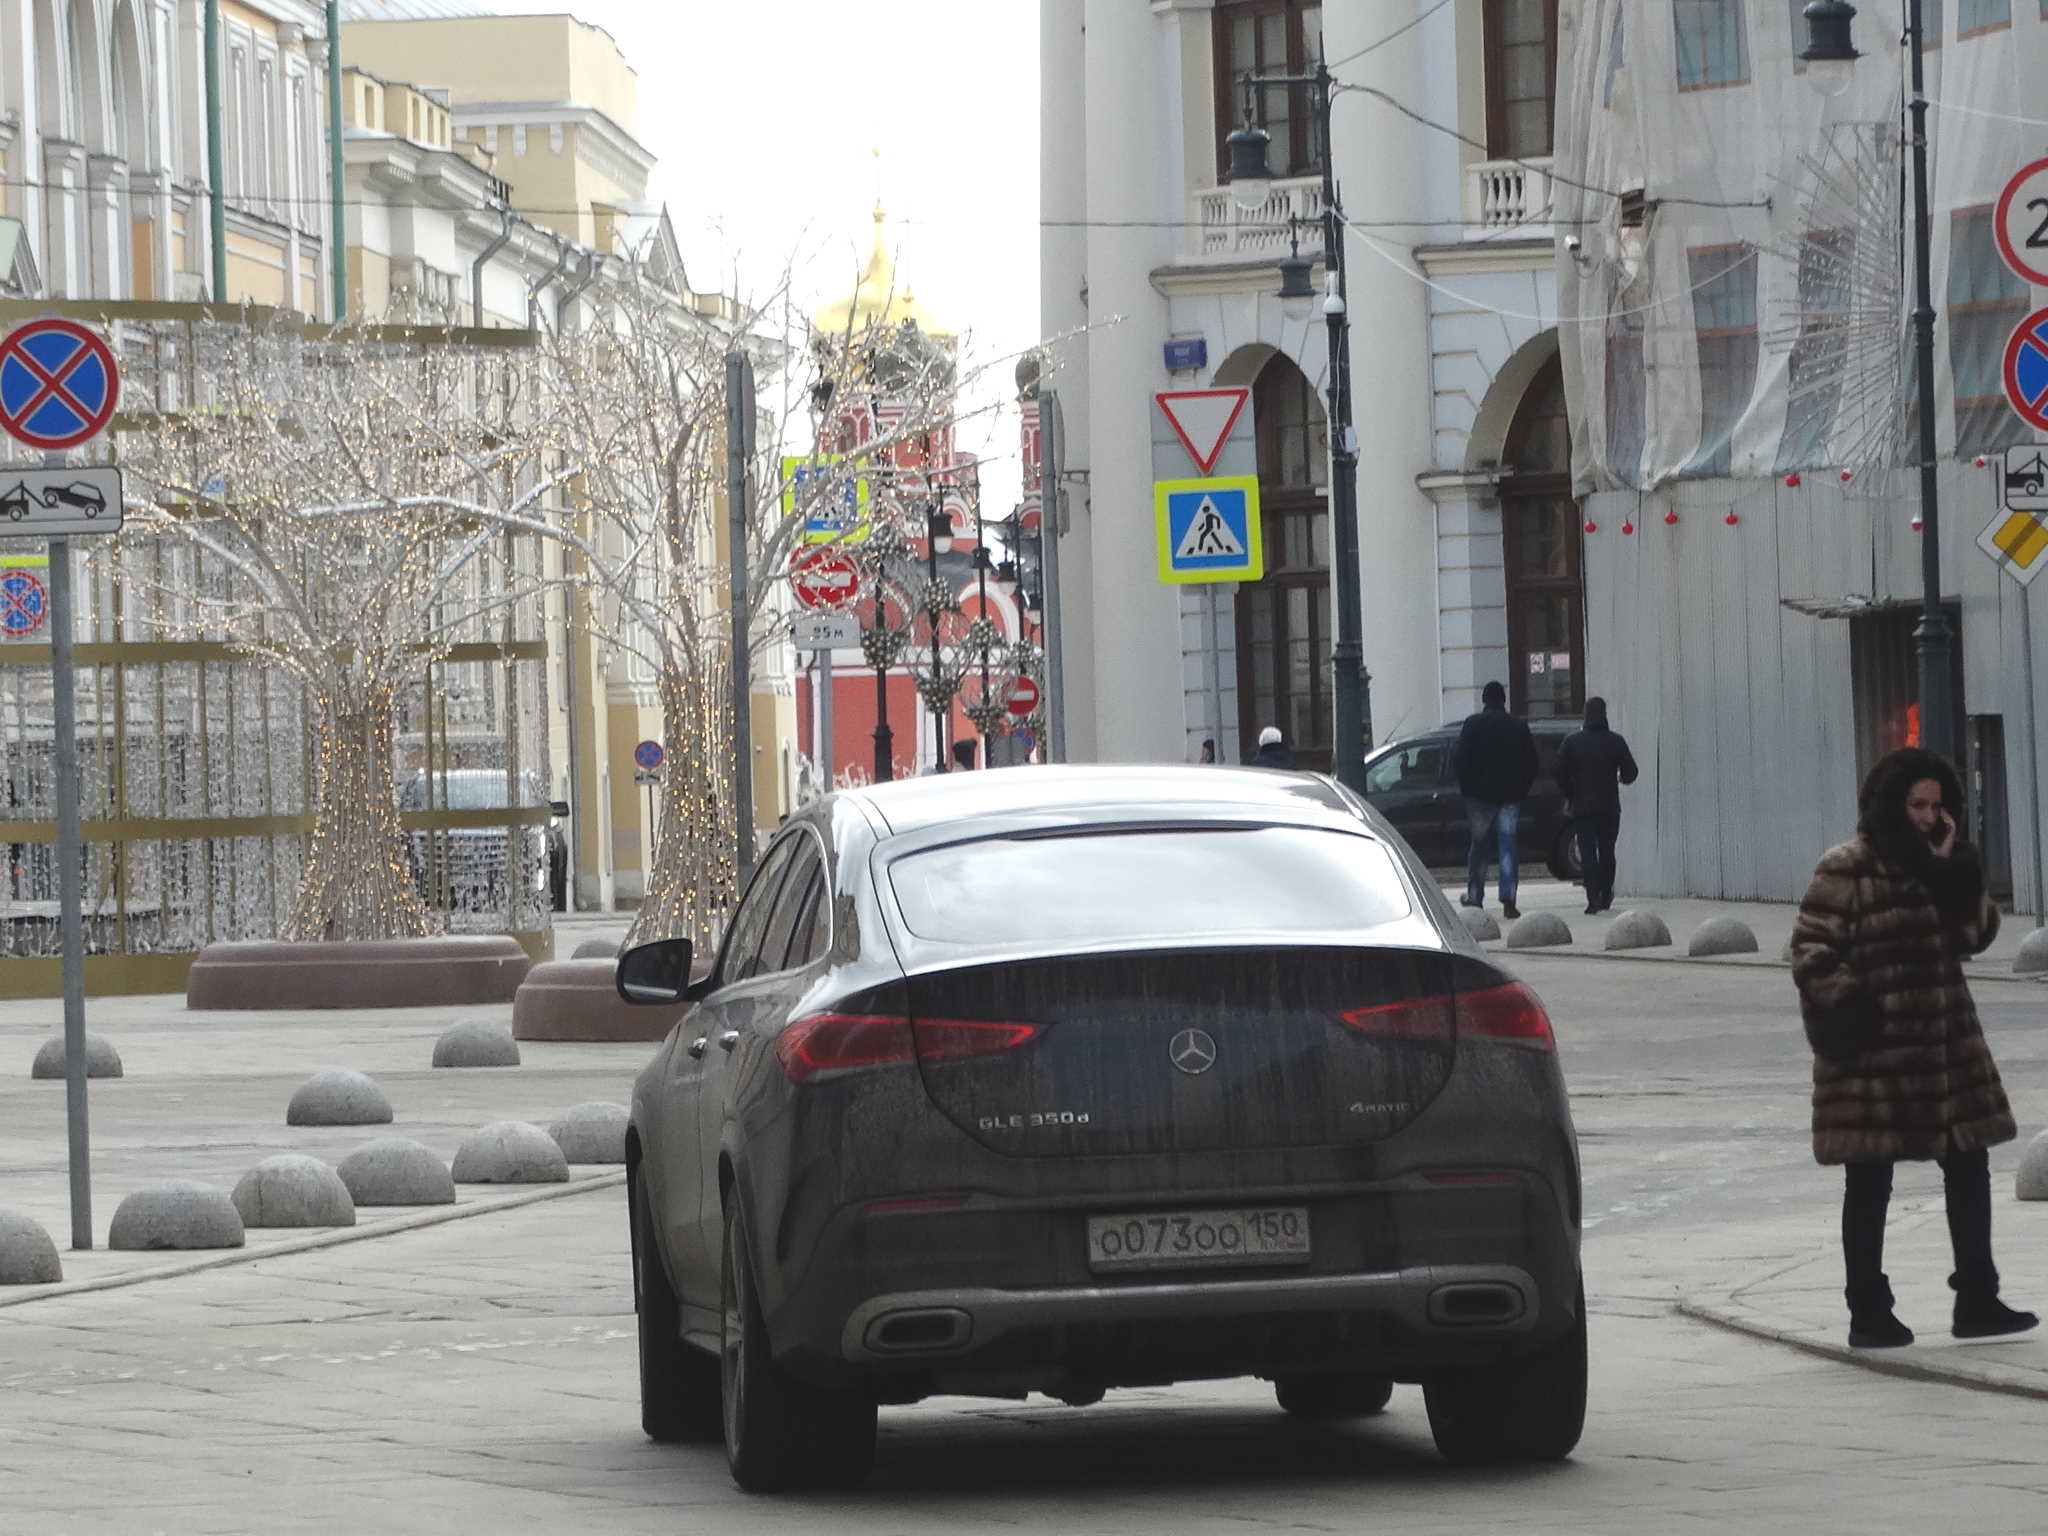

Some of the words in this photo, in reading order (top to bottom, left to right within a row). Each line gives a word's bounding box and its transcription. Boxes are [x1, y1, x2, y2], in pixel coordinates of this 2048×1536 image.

[978, 1114, 1023, 1130] GLE
[1030, 1111, 1090, 1127] 350d
[1247, 1212, 1298, 1238] 150
